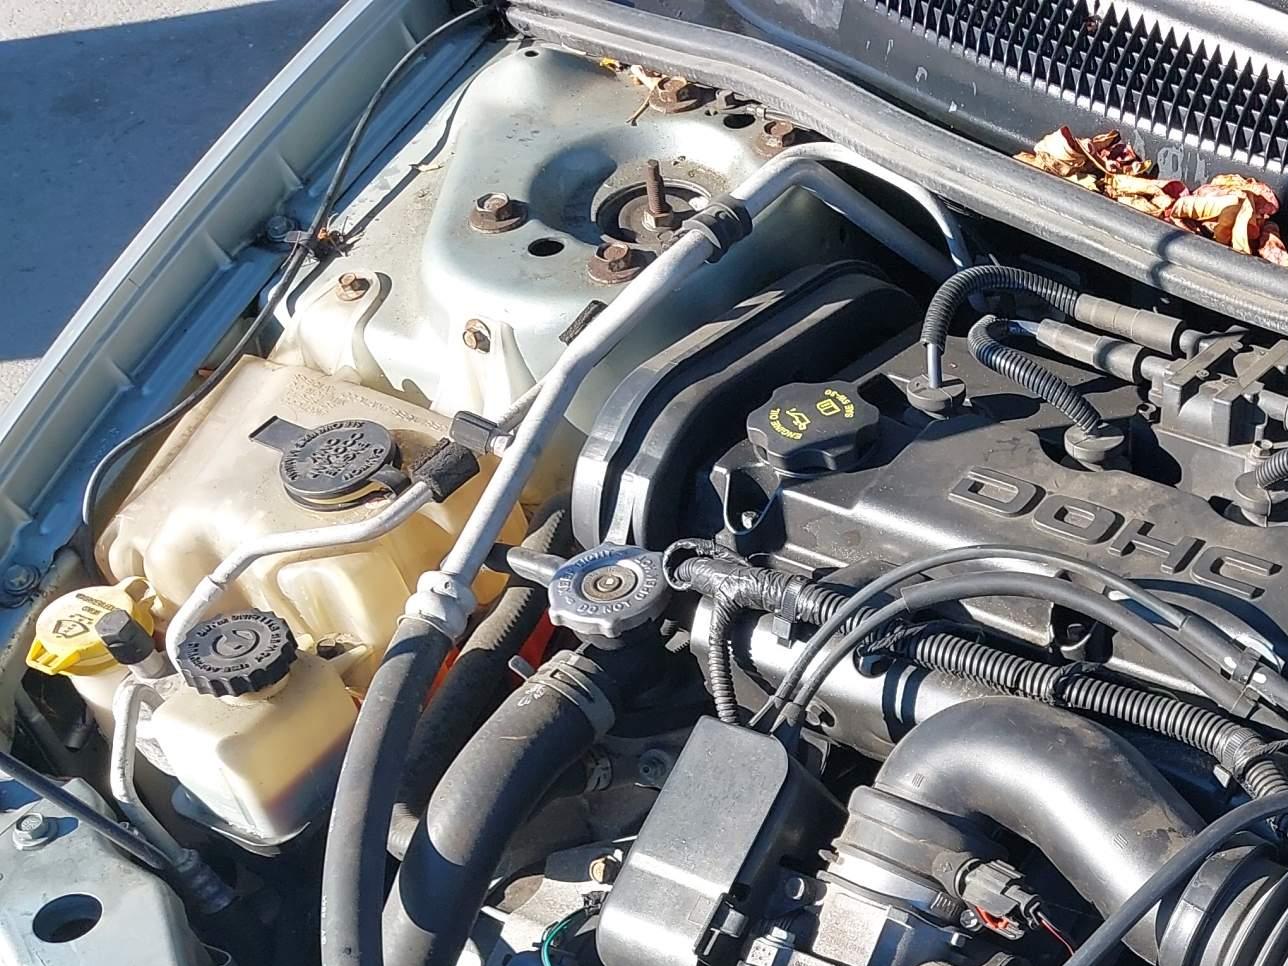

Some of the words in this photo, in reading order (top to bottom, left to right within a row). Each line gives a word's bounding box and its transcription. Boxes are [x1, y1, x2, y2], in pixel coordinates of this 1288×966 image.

[769, 408, 781, 421] OIL
[769, 420, 803, 440] ENGINE
[948, 466, 1282, 601] DOHC
[603, 600, 631, 615] NOT
